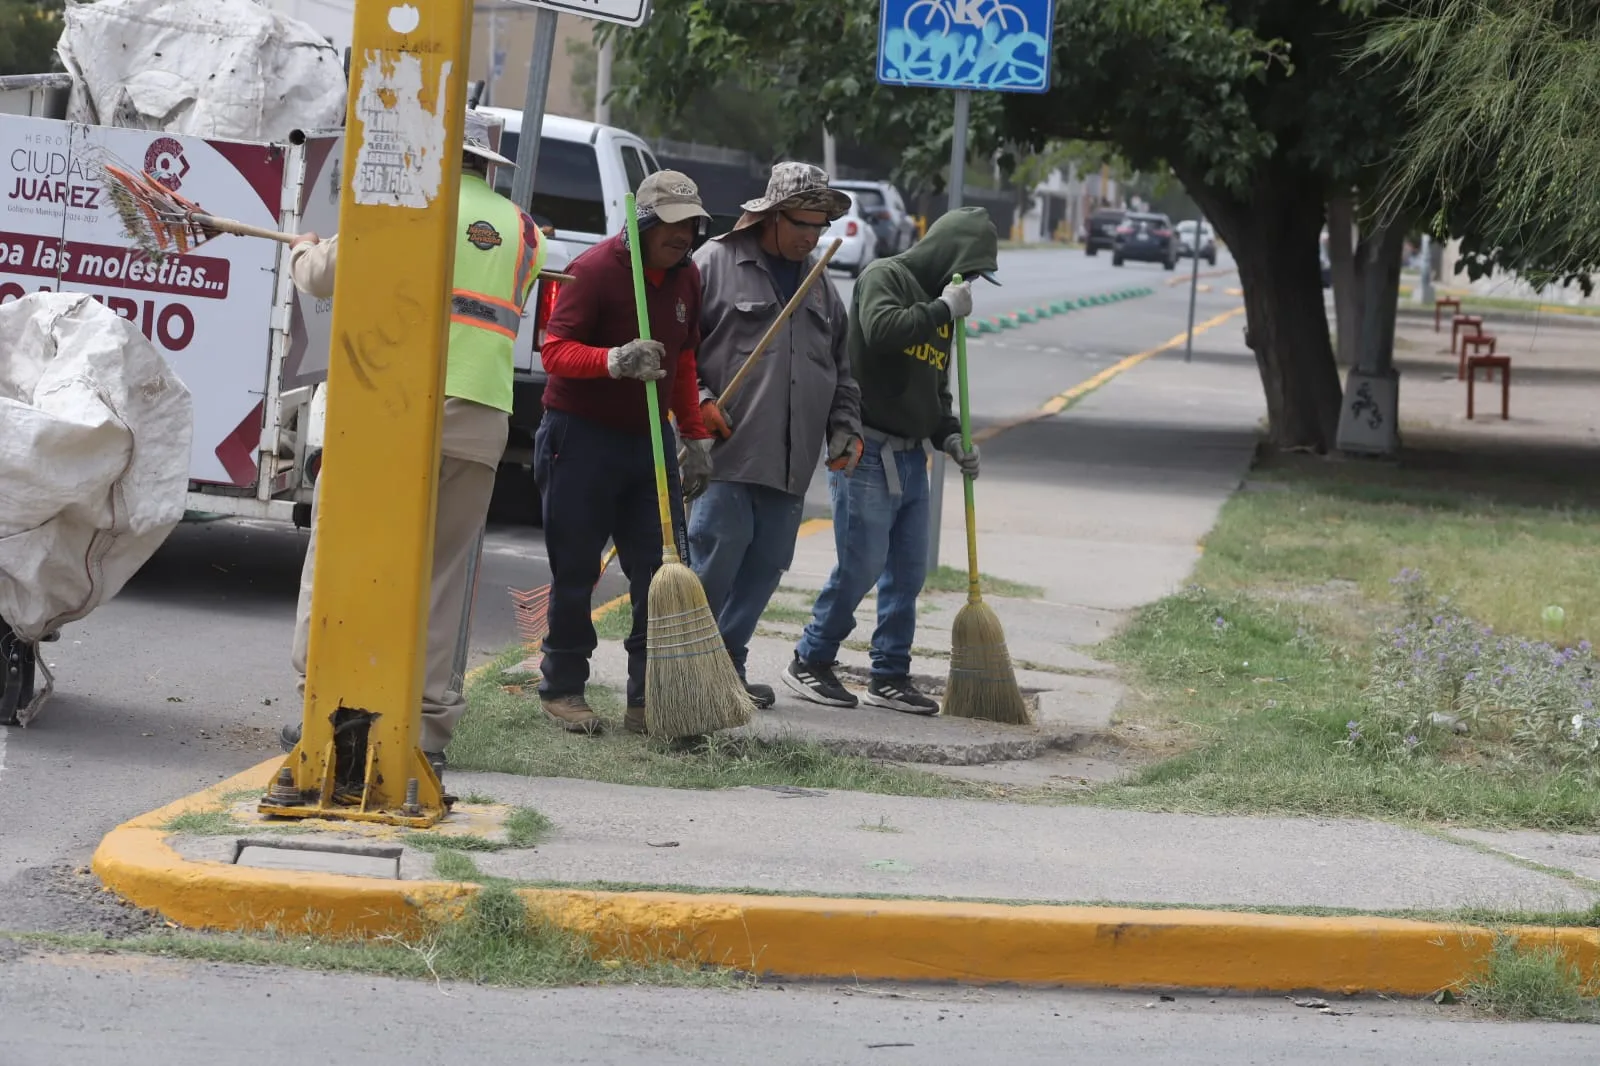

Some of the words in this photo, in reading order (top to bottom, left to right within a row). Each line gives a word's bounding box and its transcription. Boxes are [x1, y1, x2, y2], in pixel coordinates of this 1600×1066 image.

[7, 204, 34, 215] Gobierno
[8, 174, 100, 210] JUÁREZ
[32, 239, 72, 273] las
[77, 252, 224, 291] molestias...
